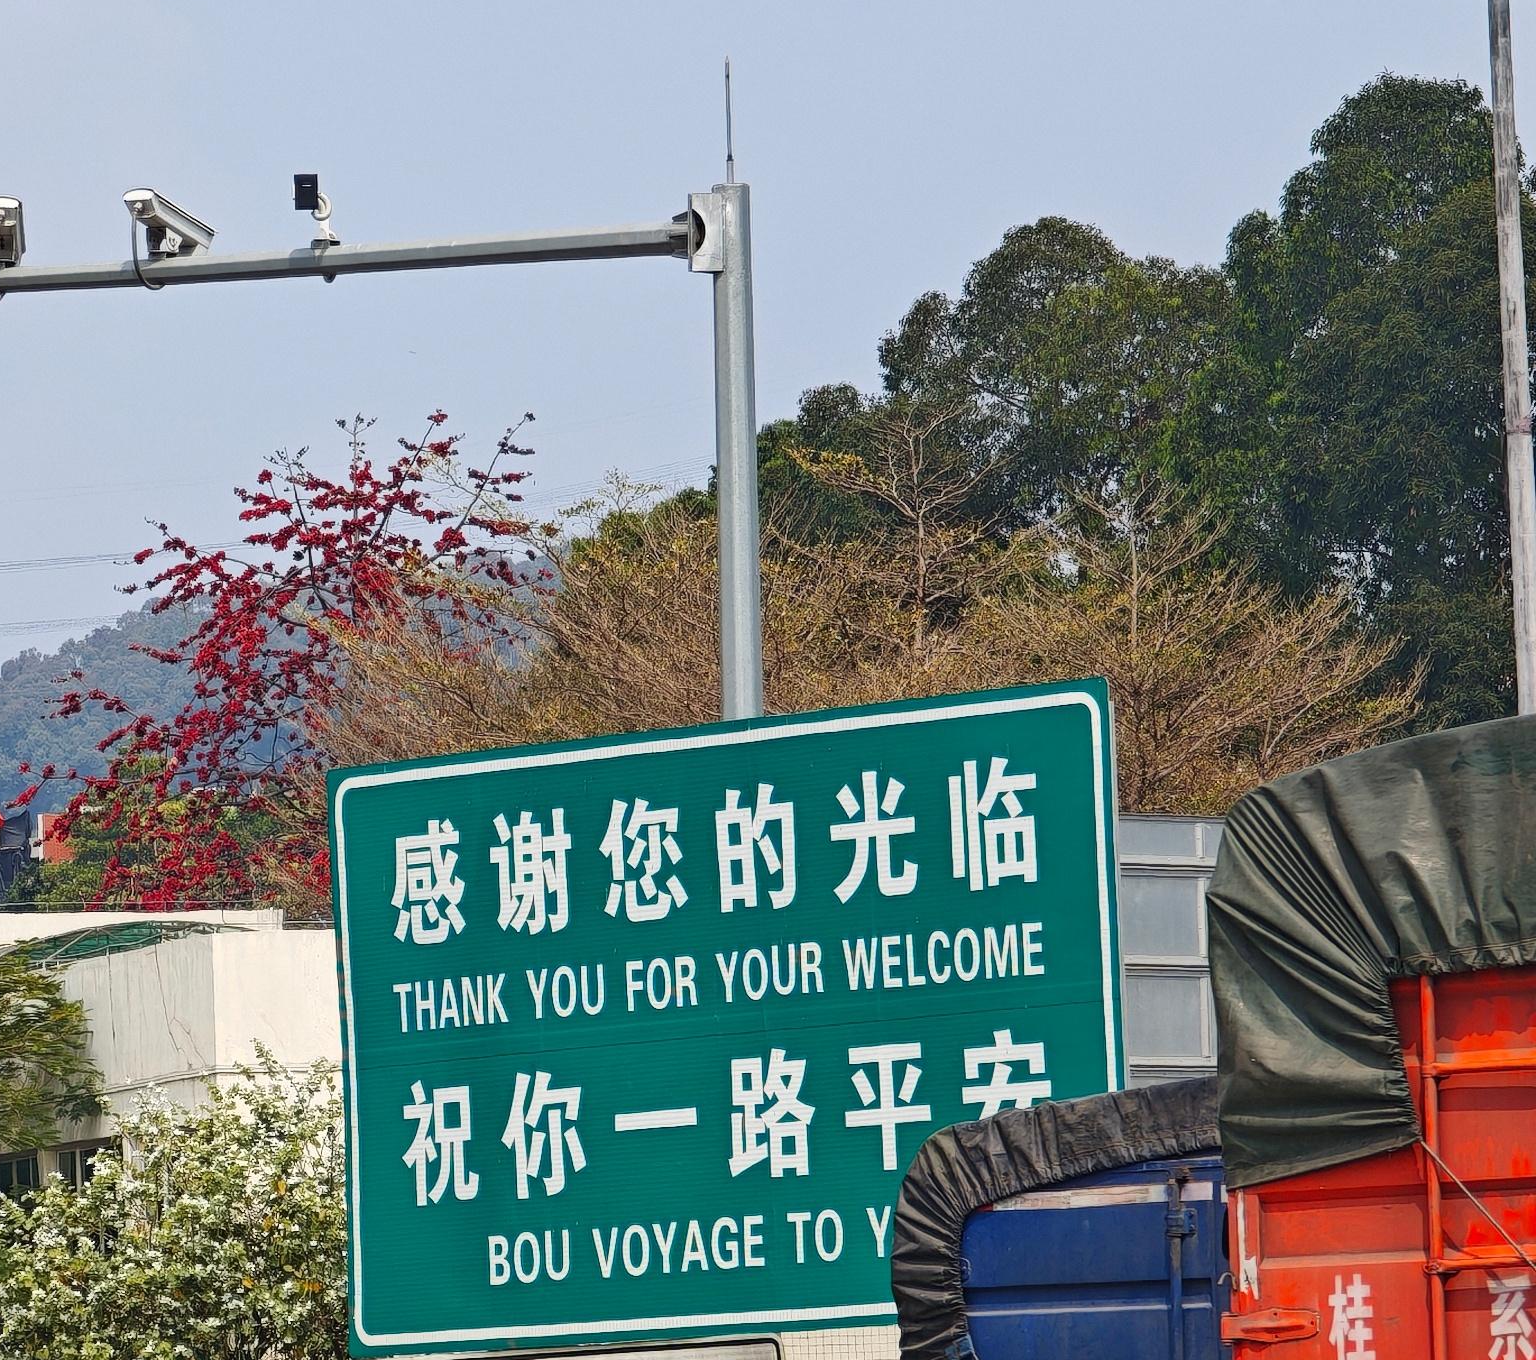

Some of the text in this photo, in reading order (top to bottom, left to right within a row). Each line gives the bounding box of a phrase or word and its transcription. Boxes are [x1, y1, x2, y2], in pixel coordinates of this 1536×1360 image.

[390, 757, 1040, 946] 感谢您的光临
[393, 921, 1046, 1033] THANK YOU FOR YOUR WELCOME
[402, 1029, 1053, 1208] 祝你一路平安
[487, 1228, 571, 1287] BOU
[592, 1214, 766, 1277] VOYAGE
[793, 1208, 845, 1266] TO
